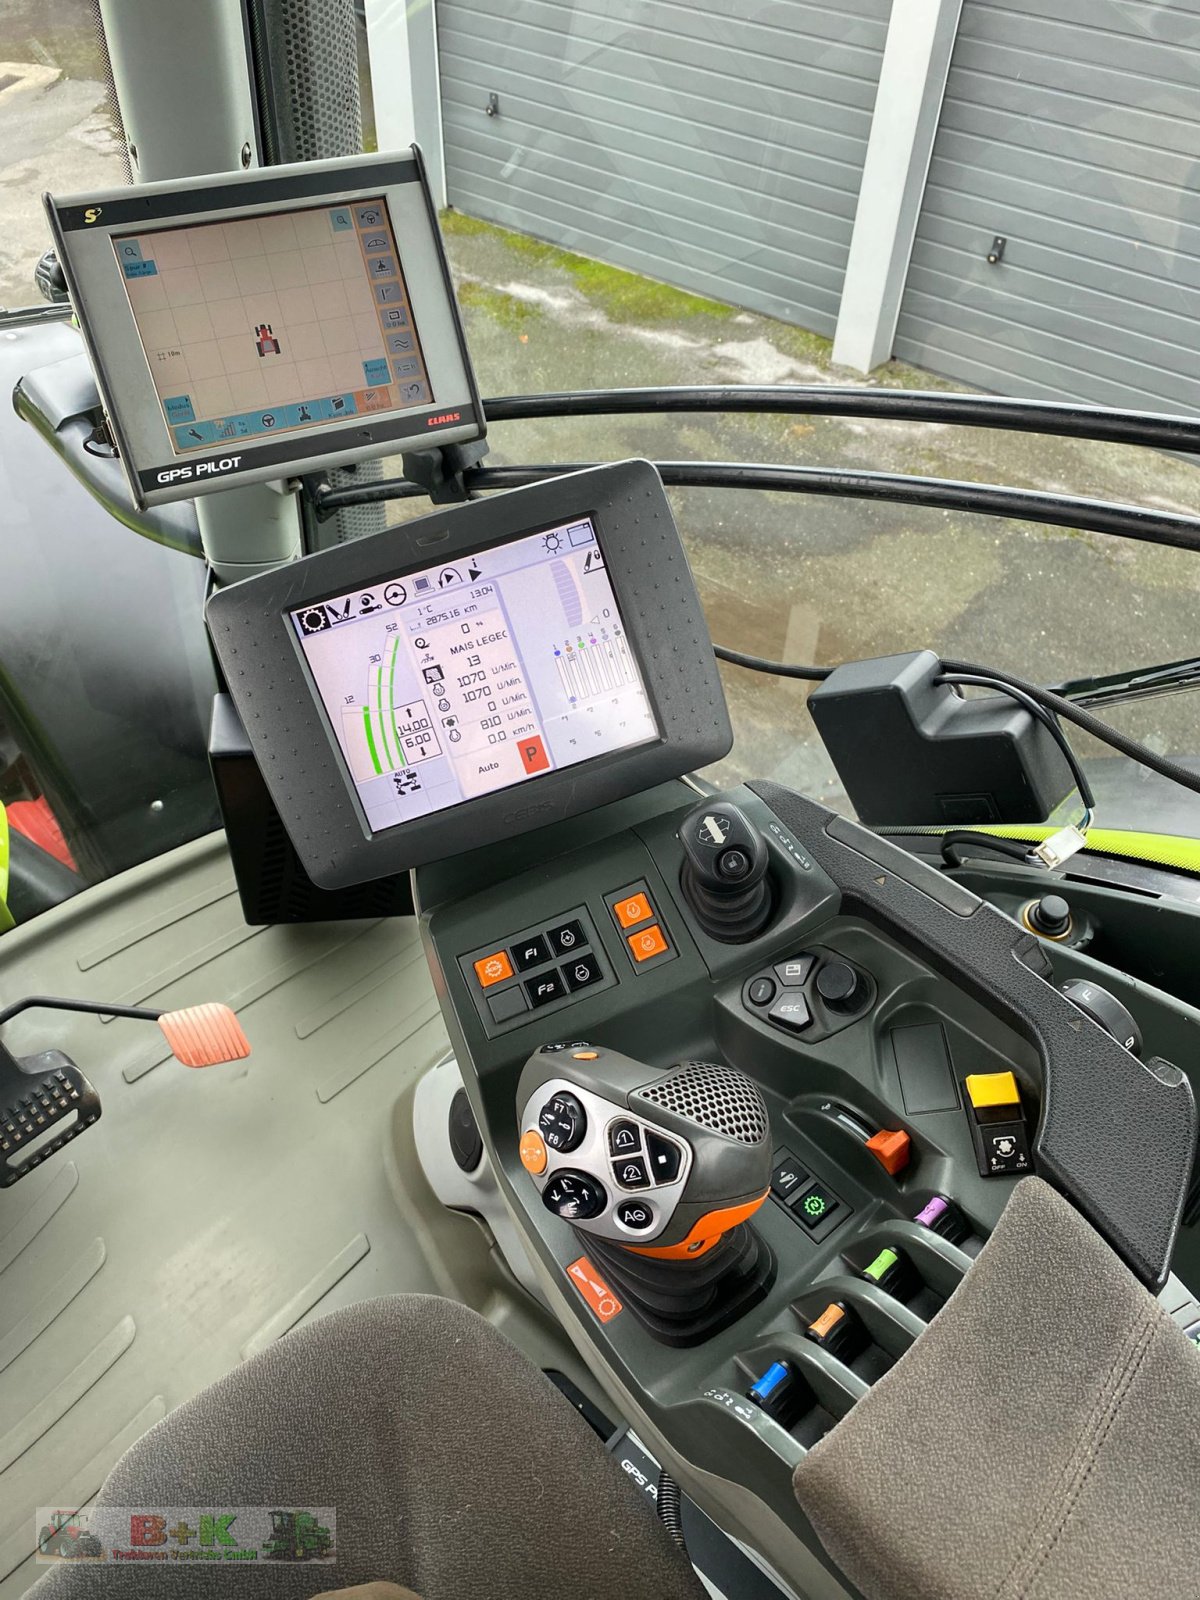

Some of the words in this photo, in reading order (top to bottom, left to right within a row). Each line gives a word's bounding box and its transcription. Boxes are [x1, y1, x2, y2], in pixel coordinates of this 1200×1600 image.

[427, 412, 460, 426] CLAAS
[157, 466, 192, 483] GPS
[196, 456, 241, 476] PILOT
[385, 622, 399, 633] 52
[460, 623, 470, 634] 0
[449, 641, 474, 655] MAIS
[369, 653, 381, 664] 30
[467, 654, 481, 667] 13
[457, 670, 486, 687] 1070
[344, 694, 355, 704] 12
[462, 685, 491, 703] 1070
[487, 700, 497, 711] 0
[398, 718, 429, 736] 14.00
[480, 715, 501, 730] 810
[405, 732, 432, 748] 6.00
[488, 730, 507, 744] 0.0
[525, 746, 537, 762] P
[394, 768, 411, 778] AUTO
[478, 762, 499, 774] Auto
[524, 947, 538, 960] F1
[537, 983, 554, 996] F2
[1082, 989, 1092, 1001] F
[780, 1004, 800, 1012] ESC
[554, 1102, 565, 1114] F7
[548, 1132, 559, 1145] F8
[627, 1167, 636, 1178] 2
[621, 1459, 648, 1486] GPS
